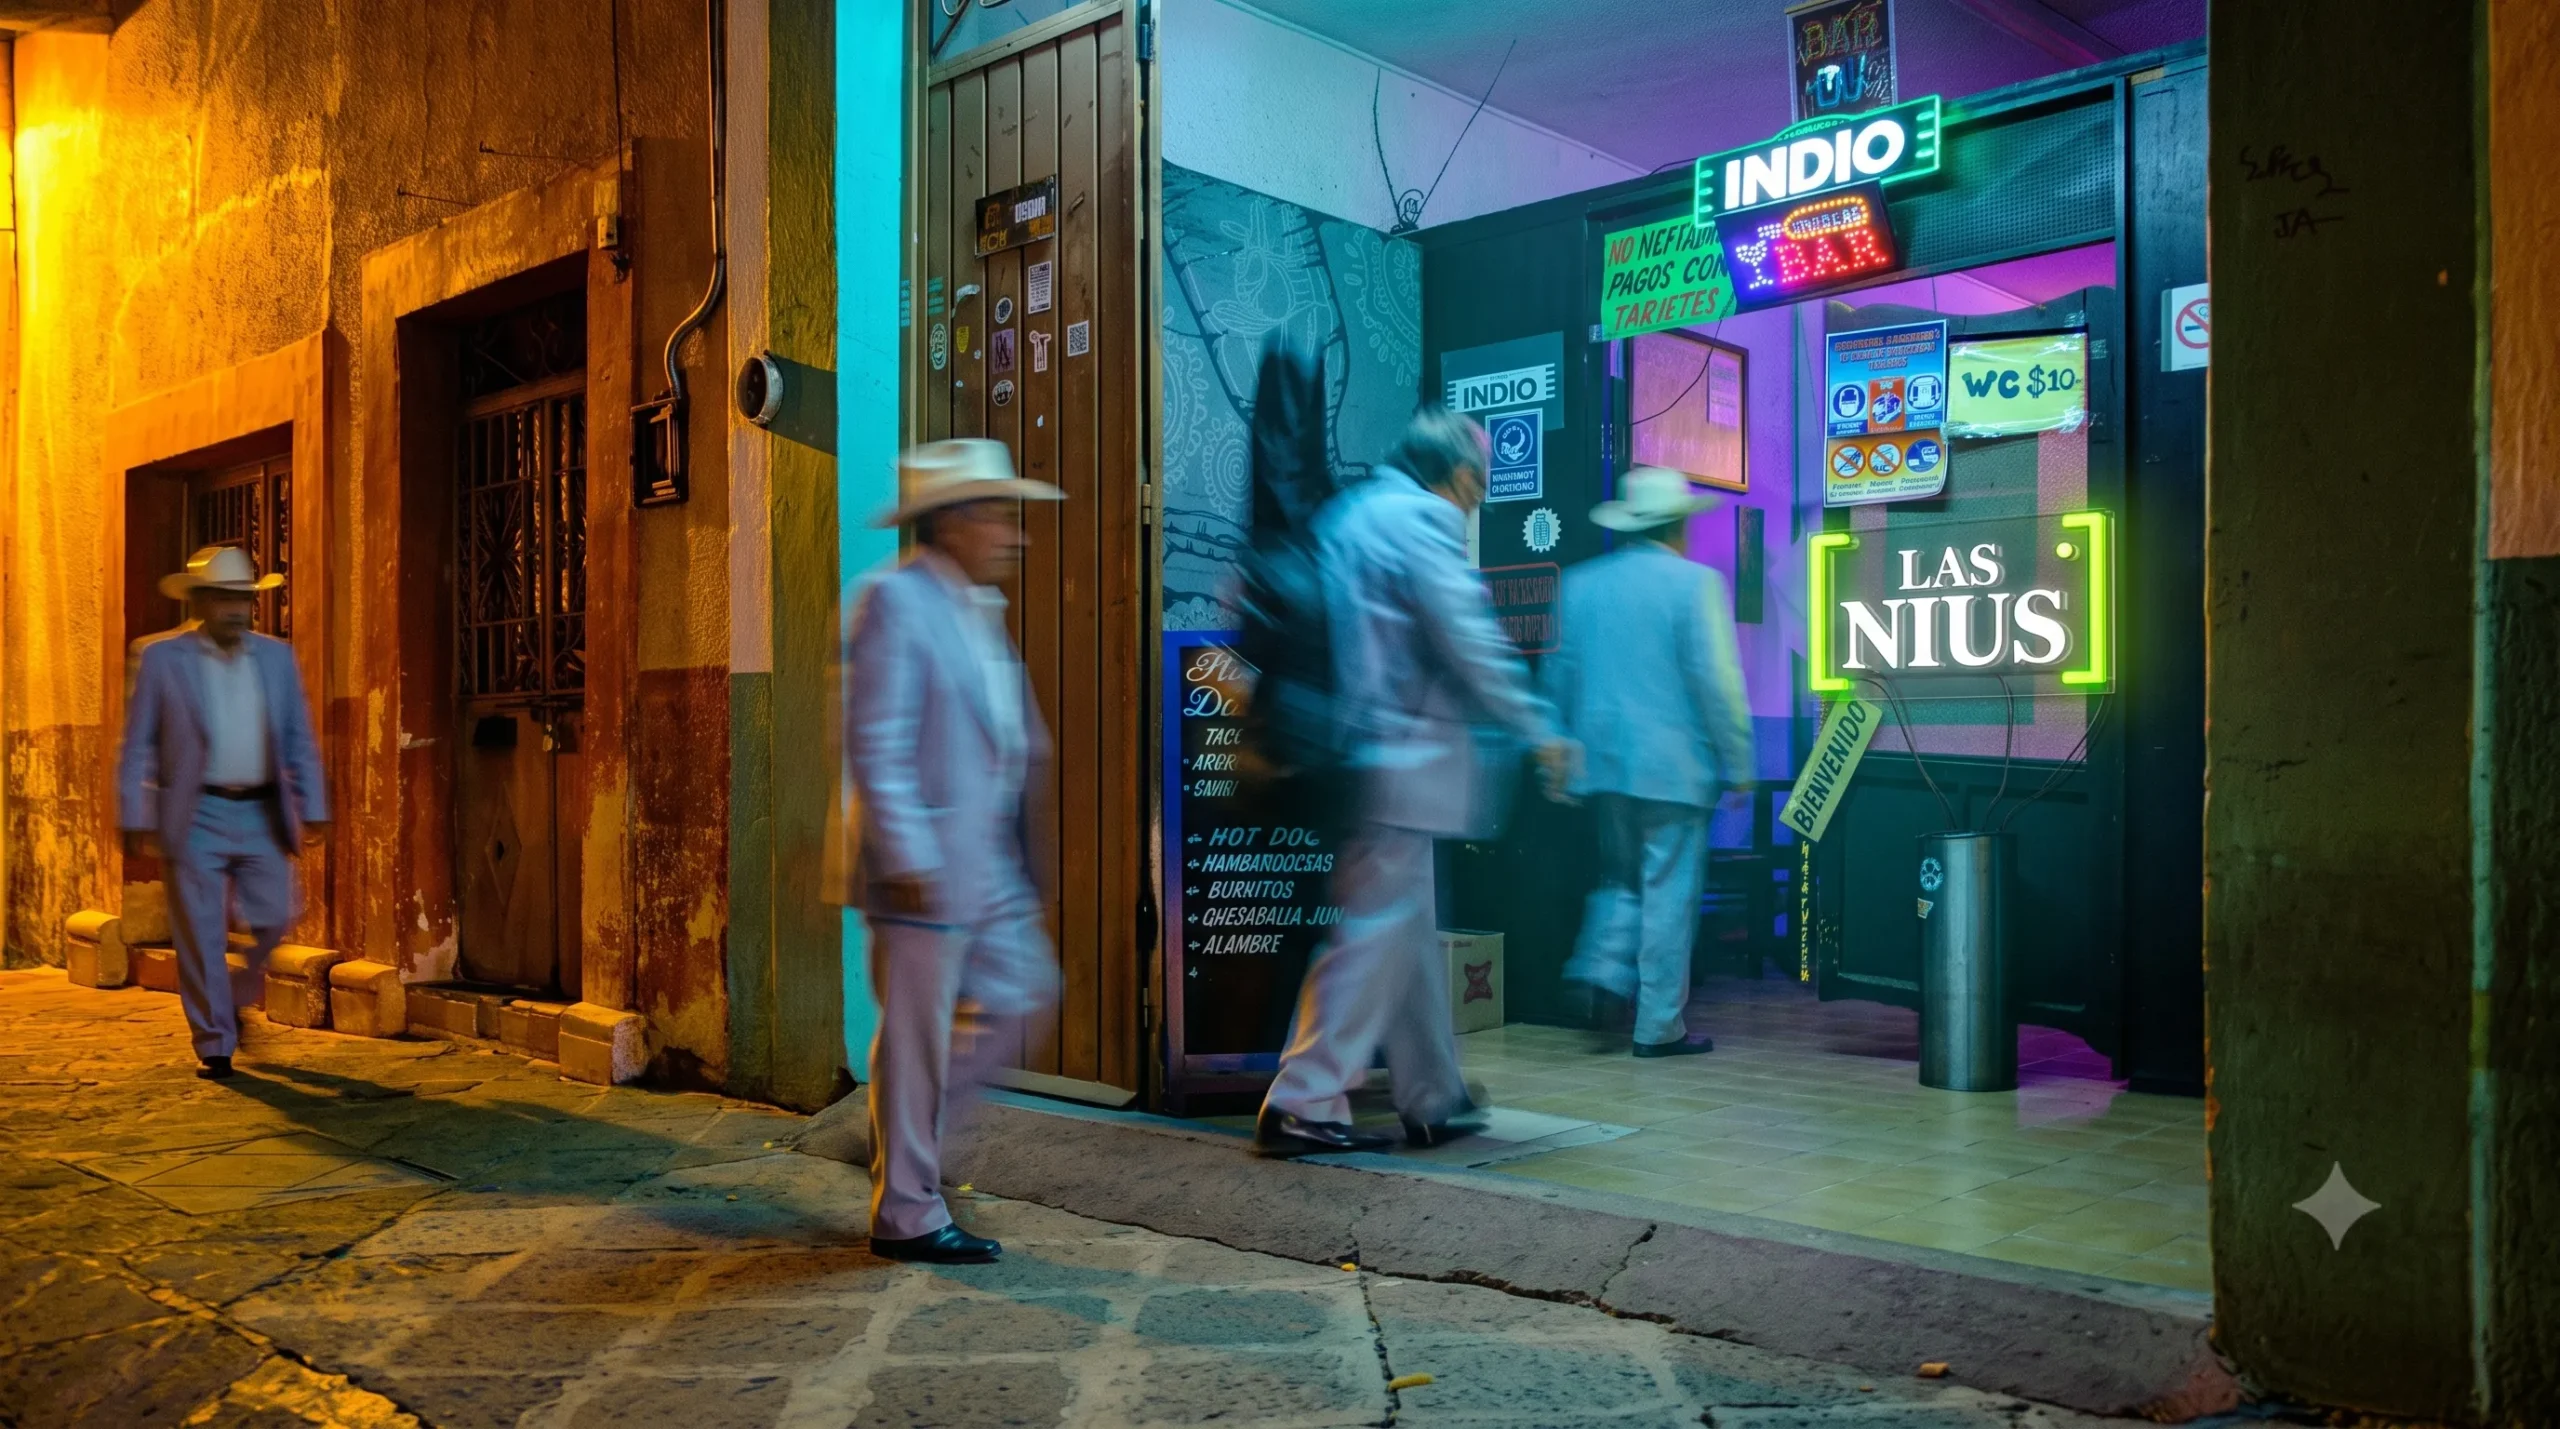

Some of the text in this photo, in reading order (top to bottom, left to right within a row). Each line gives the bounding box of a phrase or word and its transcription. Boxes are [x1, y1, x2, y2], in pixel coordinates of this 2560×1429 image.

[1724, 119, 1905, 210] INDIO
[1608, 235, 1635, 267] NO
[1774, 229, 1888, 283] BAR
[1606, 260, 1675, 301] PAGOS
[1615, 286, 1720, 332] TARIETES
[1463, 377, 1538, 409] INDIO
[1961, 369, 2020, 399] WC
[1898, 543, 2000, 590] LAS
[1839, 589, 2067, 670] NIUS
[1793, 700, 1867, 834] BIENVENIDO
[1208, 827, 1262, 847] HOT
[1202, 934, 1284, 955] ALAMBRE
